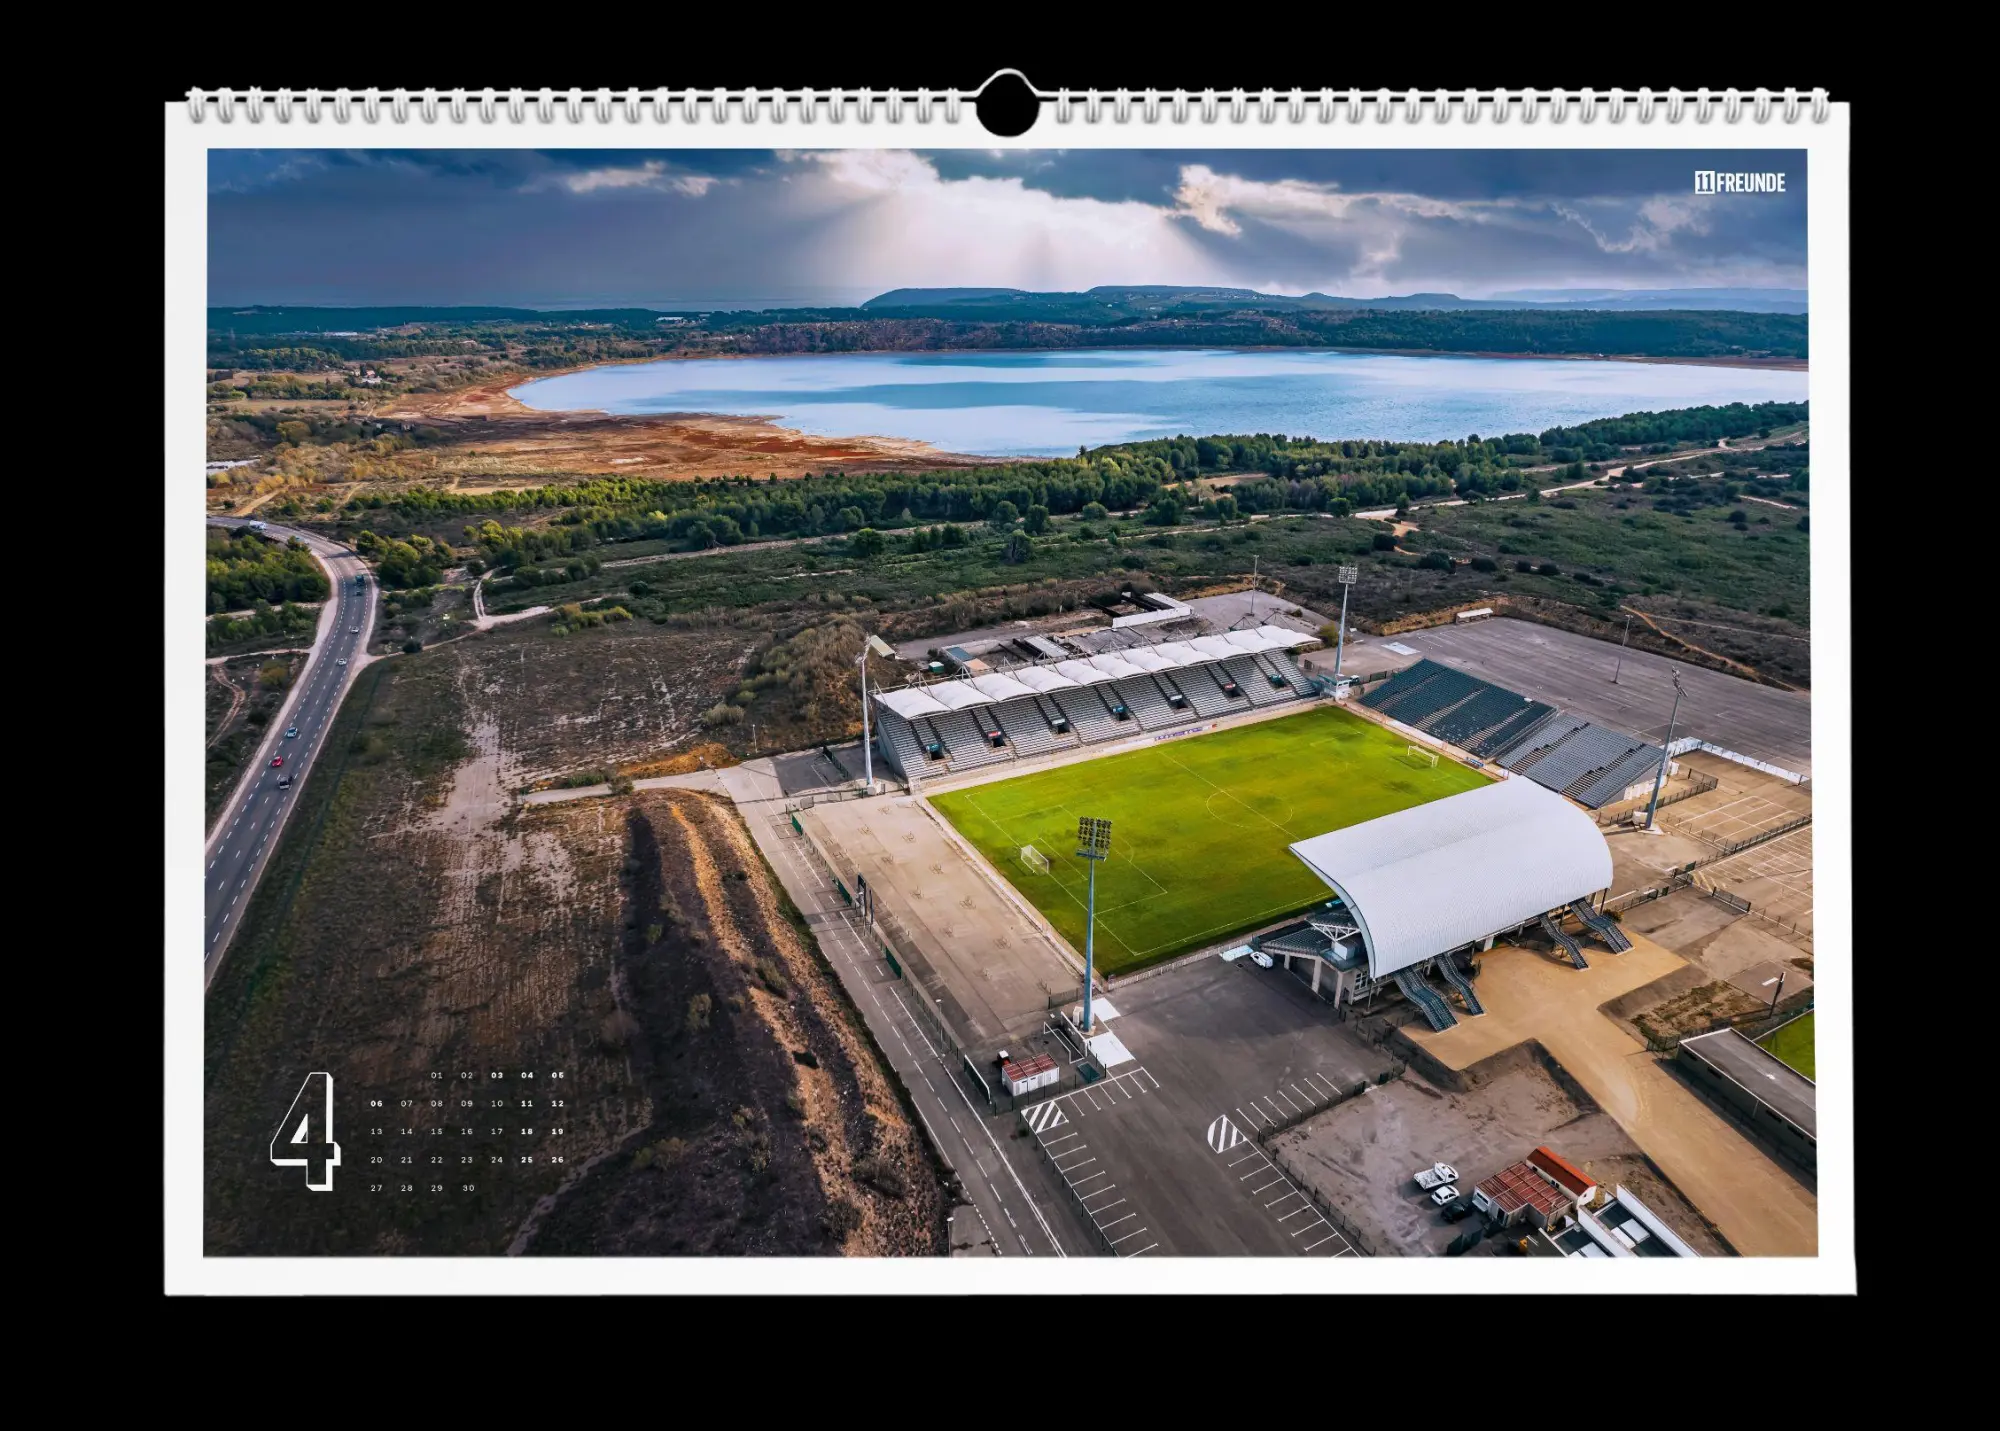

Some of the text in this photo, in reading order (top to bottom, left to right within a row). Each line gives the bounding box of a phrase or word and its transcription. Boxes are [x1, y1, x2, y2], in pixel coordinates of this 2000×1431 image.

[431, 1071, 564, 1079] 01 02 03 04 05
[371, 1100, 564, 1108] 06 07 08 09 10 11 12
[270, 1072, 341, 1191] 4
[371, 1156, 564, 1164] 20 21 22 23 24 25 26
[371, 1184, 475, 1192] 27 28 29 30
